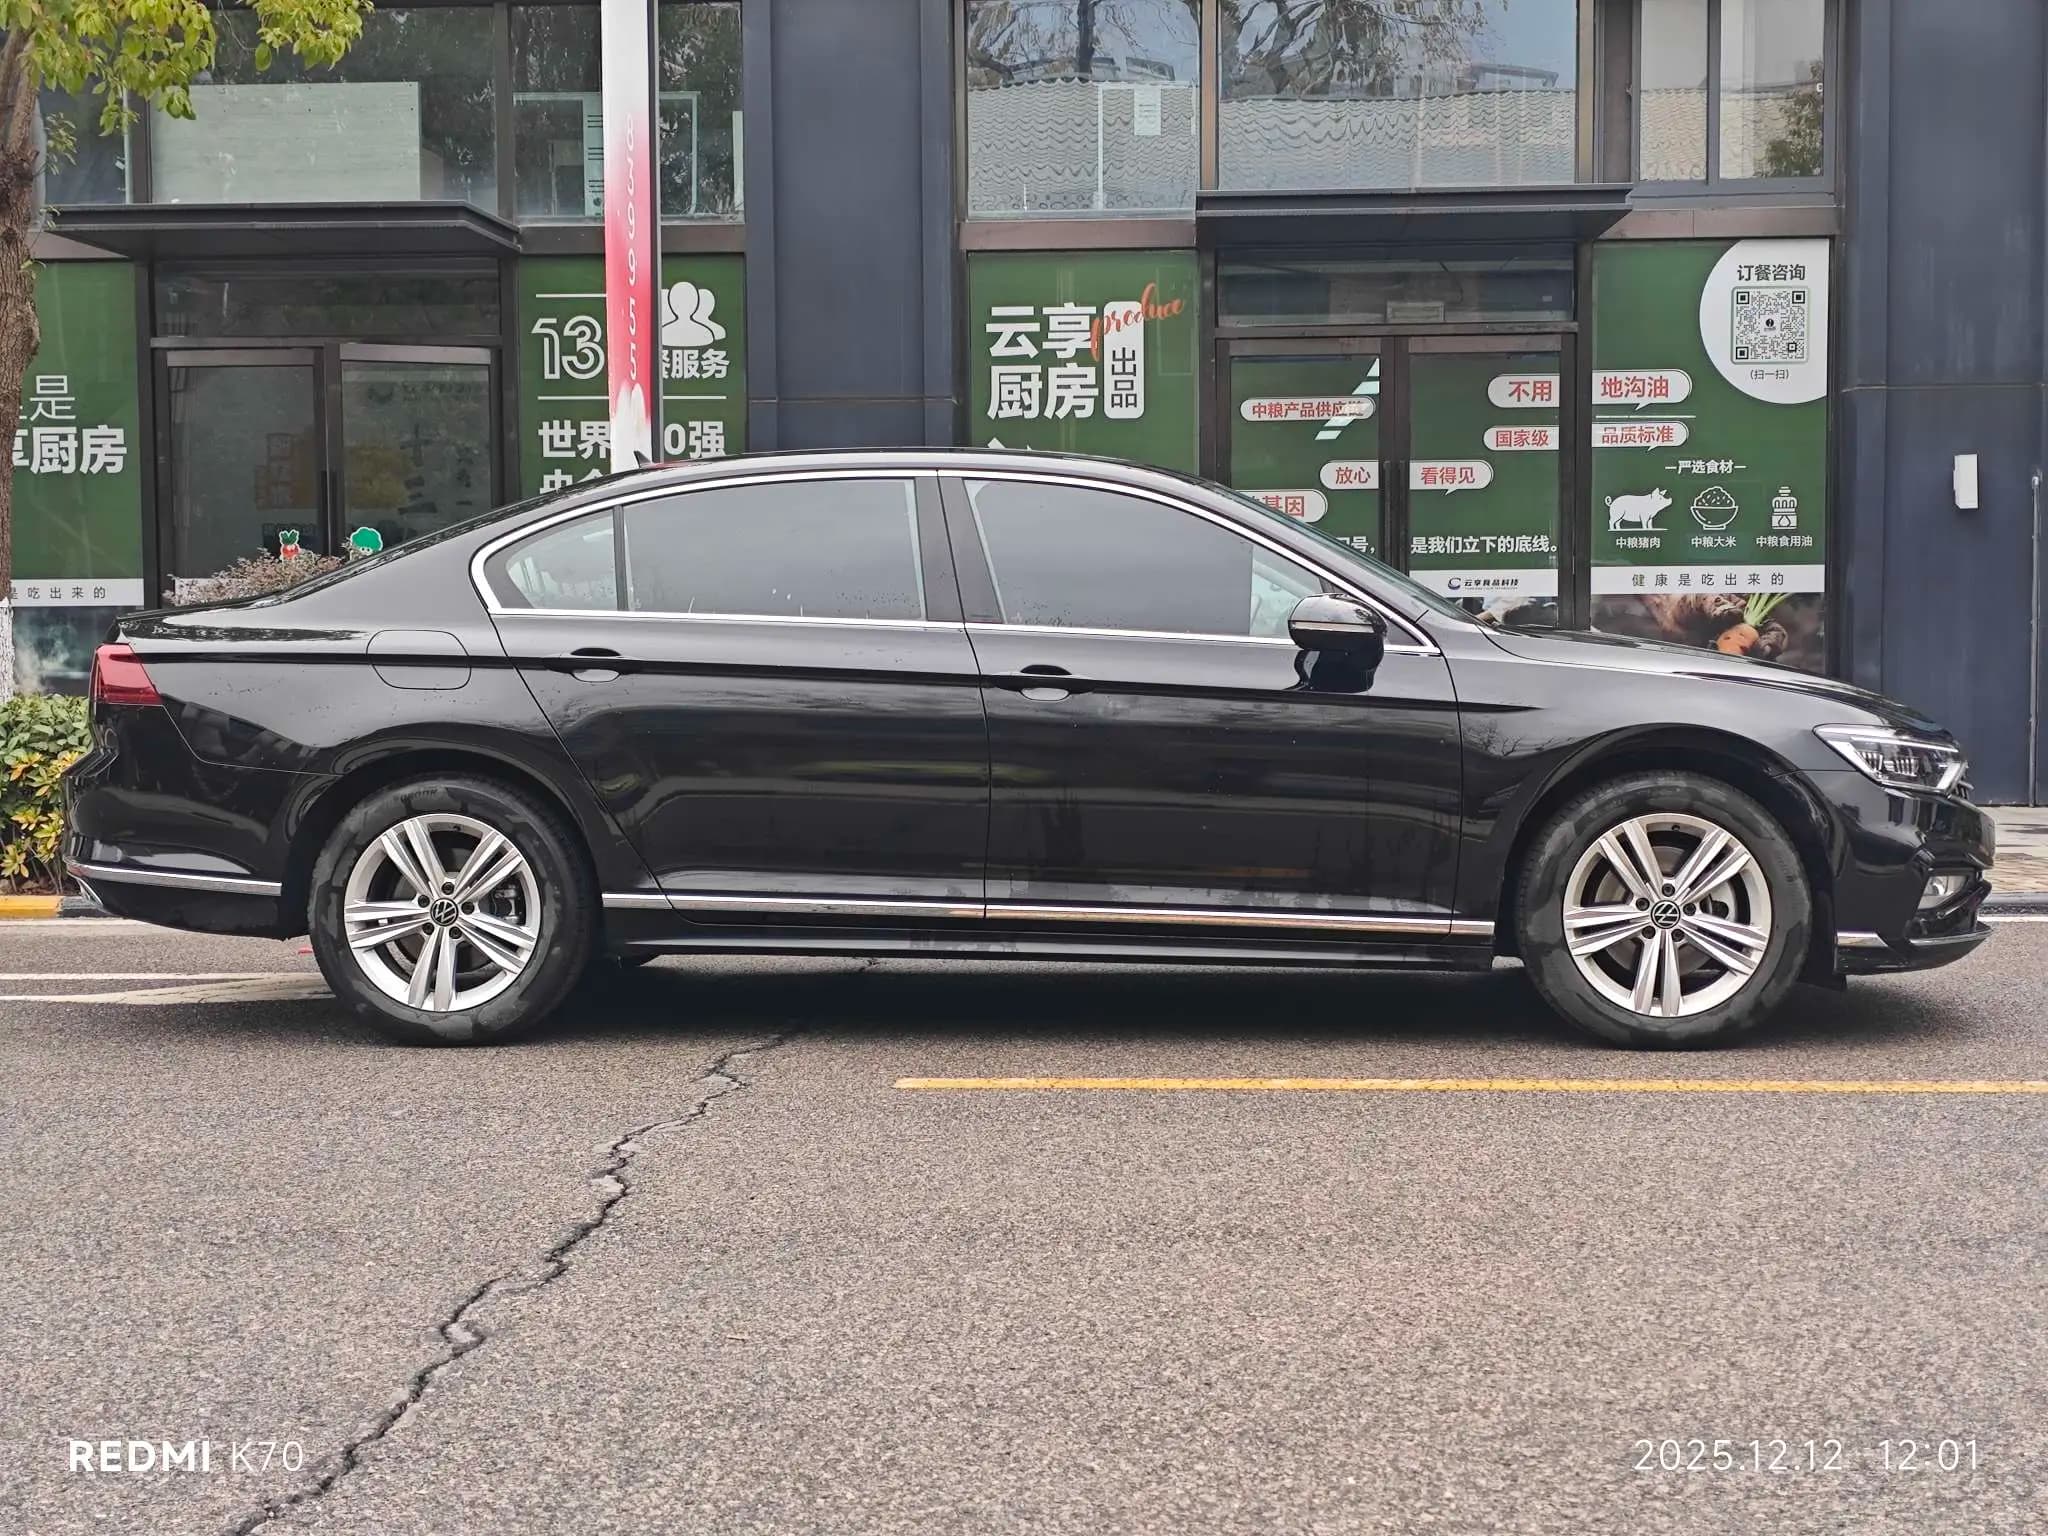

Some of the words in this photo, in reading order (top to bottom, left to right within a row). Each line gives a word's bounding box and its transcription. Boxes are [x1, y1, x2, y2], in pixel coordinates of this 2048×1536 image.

[1737, 264, 1806, 281] 订餐咨询
[986, 302, 1097, 359] 云享
[661, 348, 730, 379] 服务
[1111, 347, 1137, 408] 出品
[1750, 369, 1790, 381] (扫一扫)
[987, 363, 1099, 420] 厨房
[1508, 380, 1552, 402] 不用
[1600, 376, 1669, 398] 地沟油
[1495, 429, 1549, 448] 国家级
[1601, 426, 1674, 444] 品质标准
[1335, 467, 1371, 485] 放心
[1420, 466, 1475, 485] 看得见
[1678, 460, 1735, 474] 严选食材
[1252, 496, 1304, 517] 基因
[1411, 536, 1557, 554] 是我们立下的底线。
[1616, 536, 1661, 549] 中粮猪肉
[1691, 536, 1737, 548] 中粮大米
[1756, 535, 1813, 548] 中粮食用油
[1632, 573, 1784, 587] 健康是吃出来的
